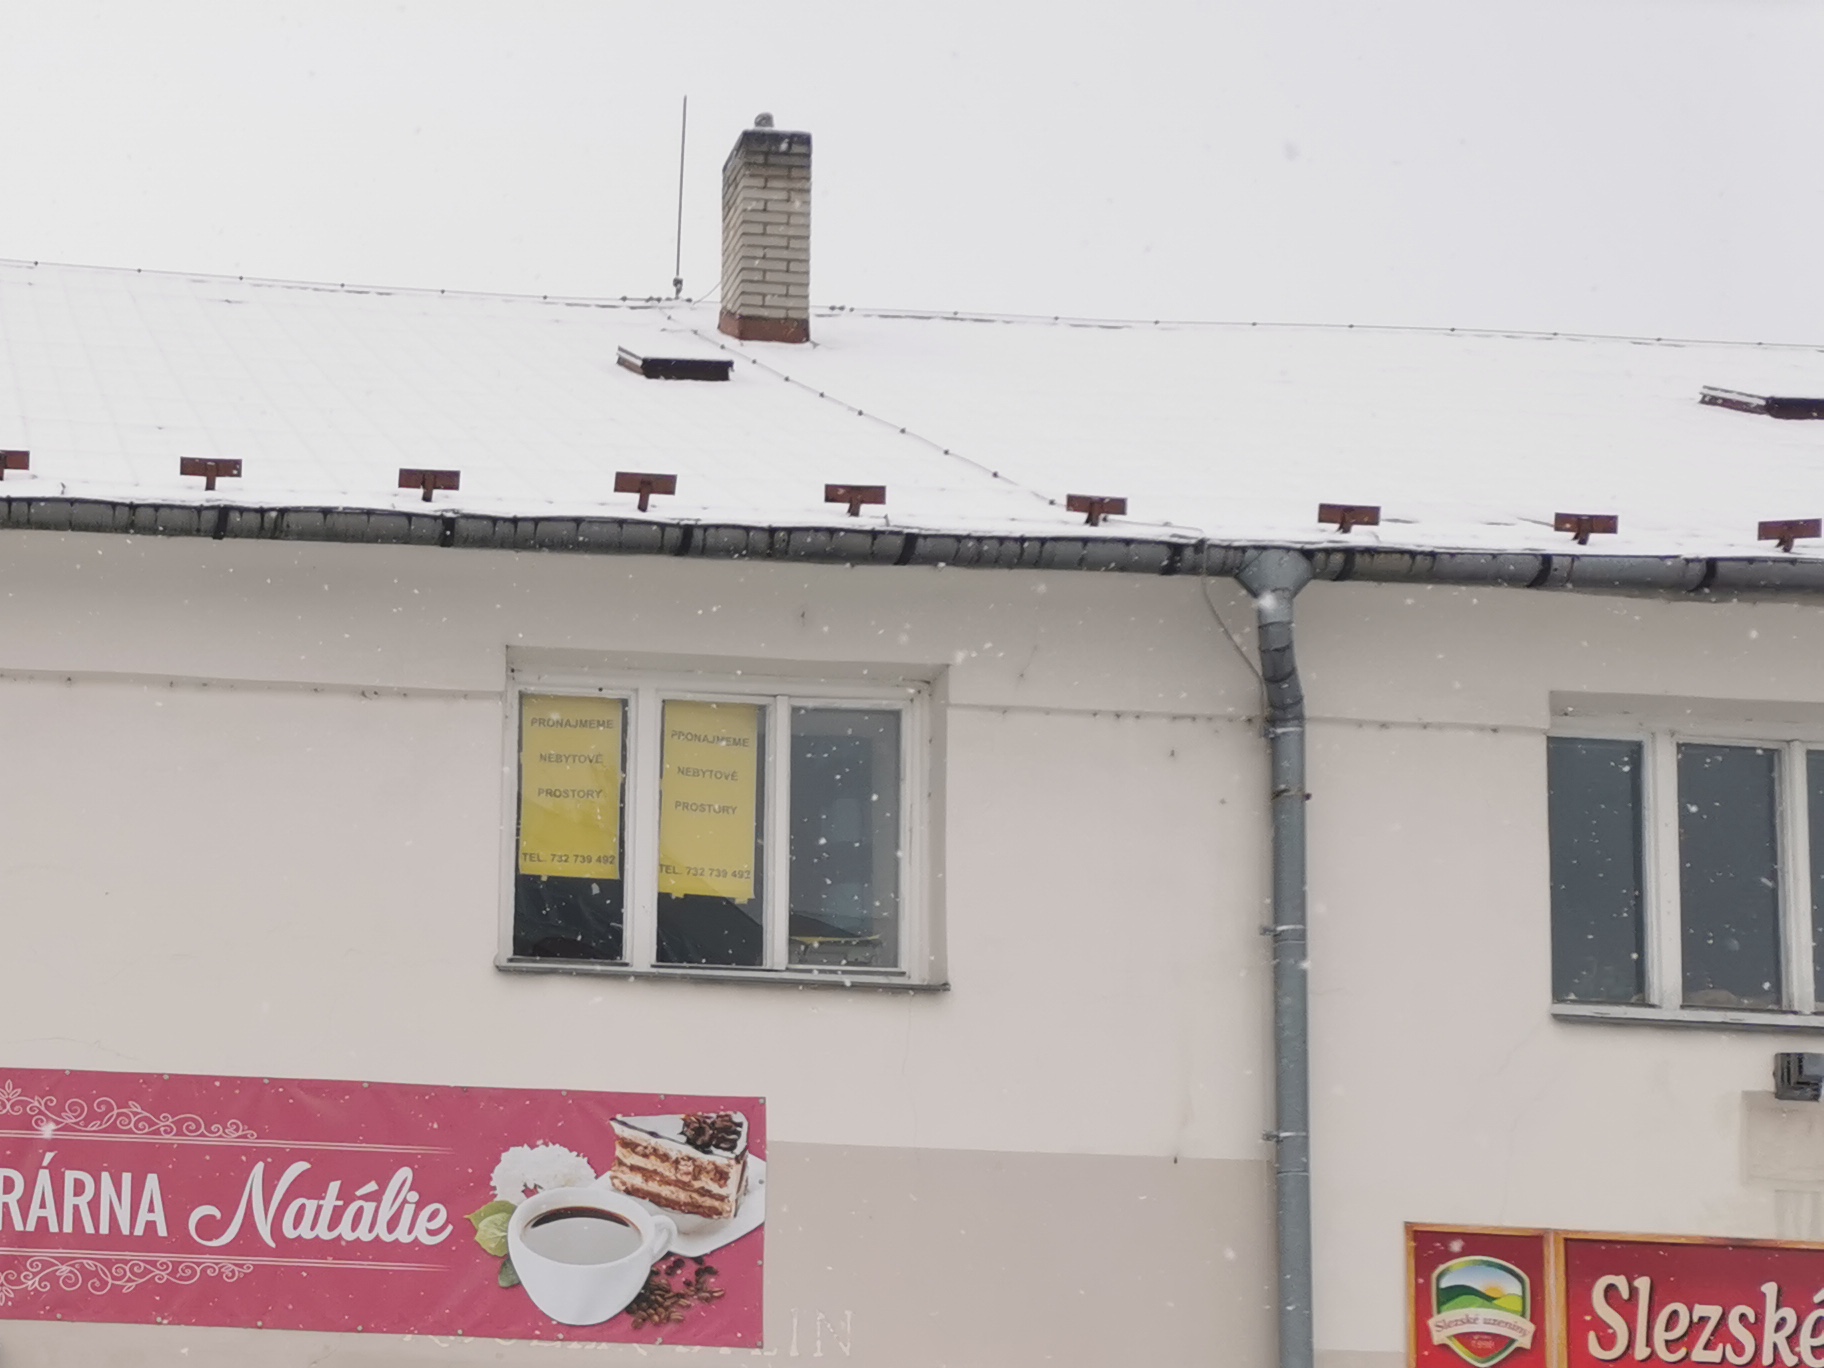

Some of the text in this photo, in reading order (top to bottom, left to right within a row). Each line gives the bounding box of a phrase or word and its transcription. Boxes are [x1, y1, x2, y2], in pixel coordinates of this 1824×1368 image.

[530, 716, 614, 730] PRONAJMEME
[539, 752, 604, 764] NEBYTOVÉ
[676, 765, 739, 781] NEBYTOVÉ
[537, 787, 604, 799] PROSTORY
[674, 800, 738, 816] PROSTORY
[550, 853, 572, 864] 732
[686, 865, 705, 877] 732
[187, 1160, 454, 1250] Natálie
